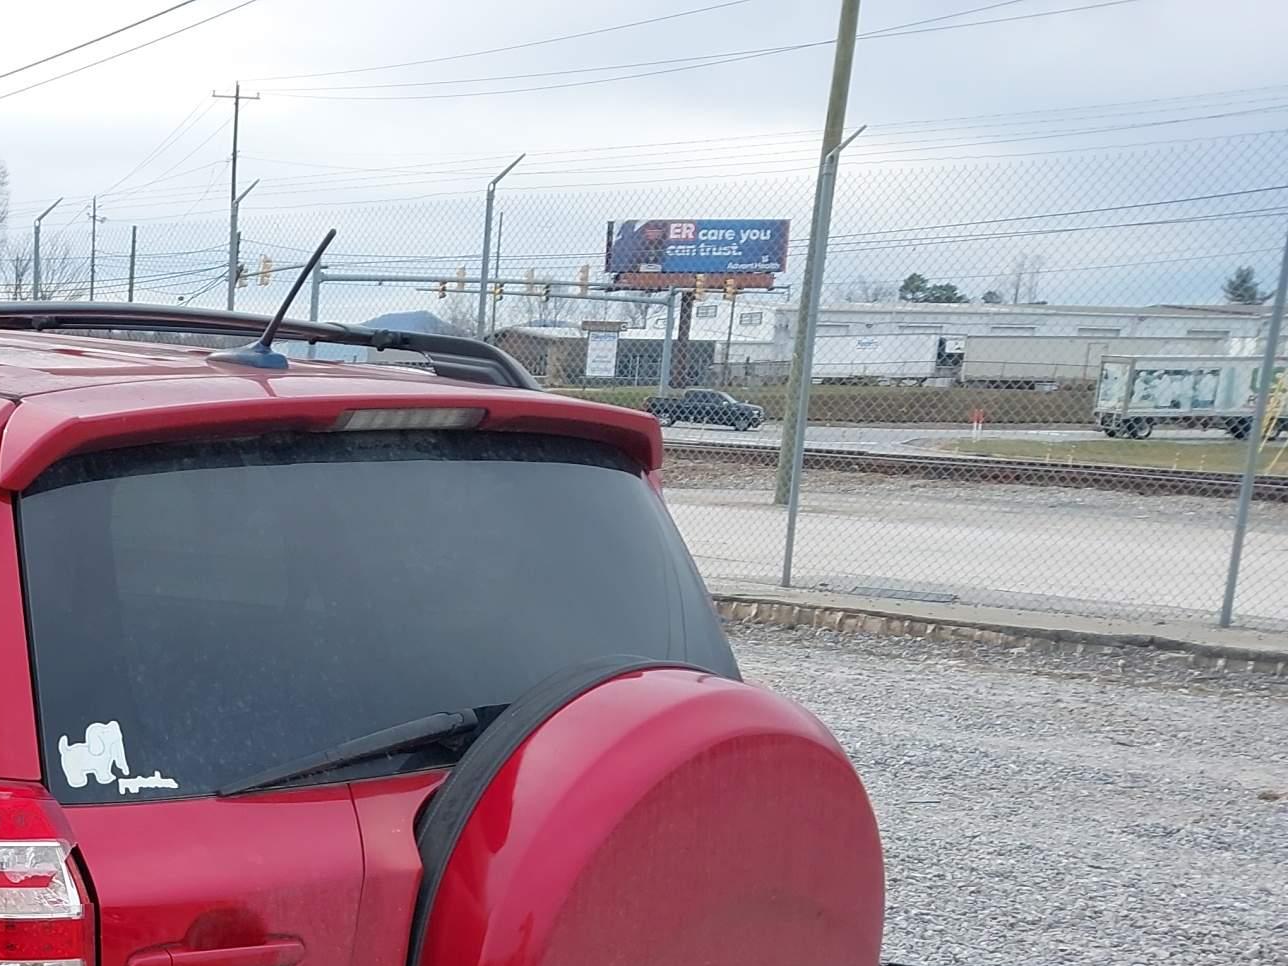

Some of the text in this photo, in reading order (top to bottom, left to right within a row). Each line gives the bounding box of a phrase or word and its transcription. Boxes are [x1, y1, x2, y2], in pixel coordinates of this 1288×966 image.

[669, 223, 771, 244] ER care you
[666, 243, 743, 256] can trust.
